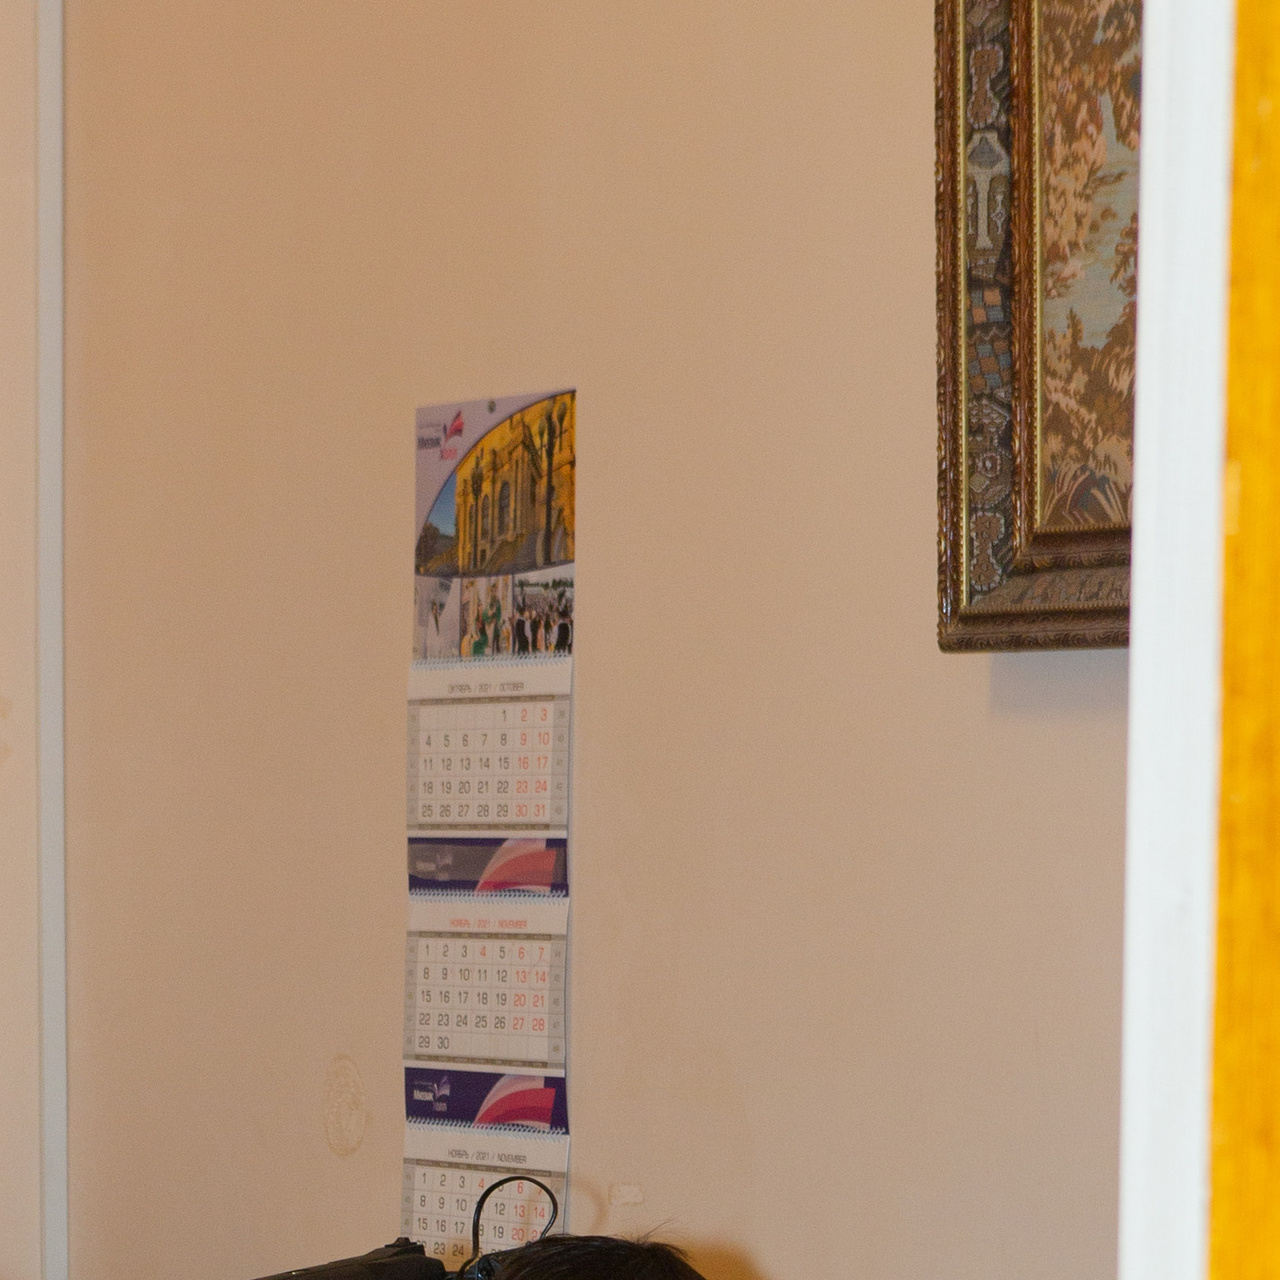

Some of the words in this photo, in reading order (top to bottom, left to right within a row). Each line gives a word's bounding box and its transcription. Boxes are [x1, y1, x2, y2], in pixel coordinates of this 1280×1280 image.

[502, 710, 507, 721] 1
[521, 708, 527, 721] 2
[541, 708, 547, 721] 3
[425, 736, 431, 747] 4
[444, 735, 450, 747] 5
[462, 734, 468, 747] 6
[482, 734, 487, 746] 7
[501, 733, 507, 746] 8
[520, 733, 527, 746] 9
[538, 732, 550, 746] 10
[423, 759, 433, 770] 11
[442, 759, 452, 770] 12
[461, 758, 470, 770] 13
[479, 757, 490, 769] 14
[498, 757, 509, 769] 15
[518, 756, 528, 769] 16
[537, 756, 548, 768] 17
[423, 782, 433, 794] 18
[441, 782, 451, 794] 19
[458, 781, 470, 794] 20
[477, 781, 489, 794] 21
[497, 780, 509, 794] 22
[516, 781, 528, 794] 23
[535, 781, 547, 793] 24
[422, 805, 433, 817] 25
[439, 805, 451, 817] 26
[458, 805, 469, 817] 27
[477, 805, 489, 817] 28
[496, 804, 508, 817] 29
[515, 804, 528, 817] 30
[534, 804, 545, 817] 31
[425, 944, 430, 955] 1
[443, 945, 448, 957] 2
[462, 945, 467, 958] 3
[480, 946, 486, 958] 4
[499, 946, 505, 959] 5
[519, 947, 525, 959] 6
[539, 948, 544, 959] 7
[423, 967, 429, 979] 8
[442, 968, 448, 980] 9
[459, 969, 470, 981] 10
[478, 969, 487, 981] 11
[497, 970, 507, 982] 12
[515, 971, 526, 983] 13
[535, 971, 546, 983] 14
[421, 991, 431, 1003] 15
[440, 991, 450, 1003] 16
[458, 992, 469, 1003] 17
[477, 993, 488, 1005] 18
[496, 993, 507, 1006] 19
[513, 994, 526, 1006] 20
[533, 995, 544, 1007] 21
[419, 1013, 430, 1025] 22
[437, 1014, 449, 1026] 23
[456, 1015, 468, 1027] 24
[475, 1016, 487, 1028] 25
[494, 1017, 505, 1029] 26
[513, 1018, 524, 1030] 27
[532, 1019, 545, 1031] 28
[419, 1036, 430, 1048] 29
[437, 1037, 450, 1049] 30
[476, 1151, 489, 1161] 2021
[497, 1153, 527, 1164] NOVEMBER
[422, 1173, 427, 1184] 1
[440, 1174, 446, 1186] 2
[459, 1176, 465, 1188] 3
[478, 1178, 484, 1190] 4
[517, 1181, 524, 1194] 6
[420, 1195, 426, 1207] 8
[439, 1197, 445, 1209] 9
[456, 1199, 467, 1211] 10
[495, 1202, 505, 1215] 12
[514, 1205, 525, 1217] 13
[534, 1207, 545, 1219] 14
[418, 1218, 428, 1230] 15
[436, 1220, 446, 1232] 16
[454, 1222, 465, 1234] 17
[493, 1226, 504, 1238] 19
[512, 1229, 524, 1241] 20
[434, 1242, 446, 1255] 23
[452, 1244, 464, 1257] 24
